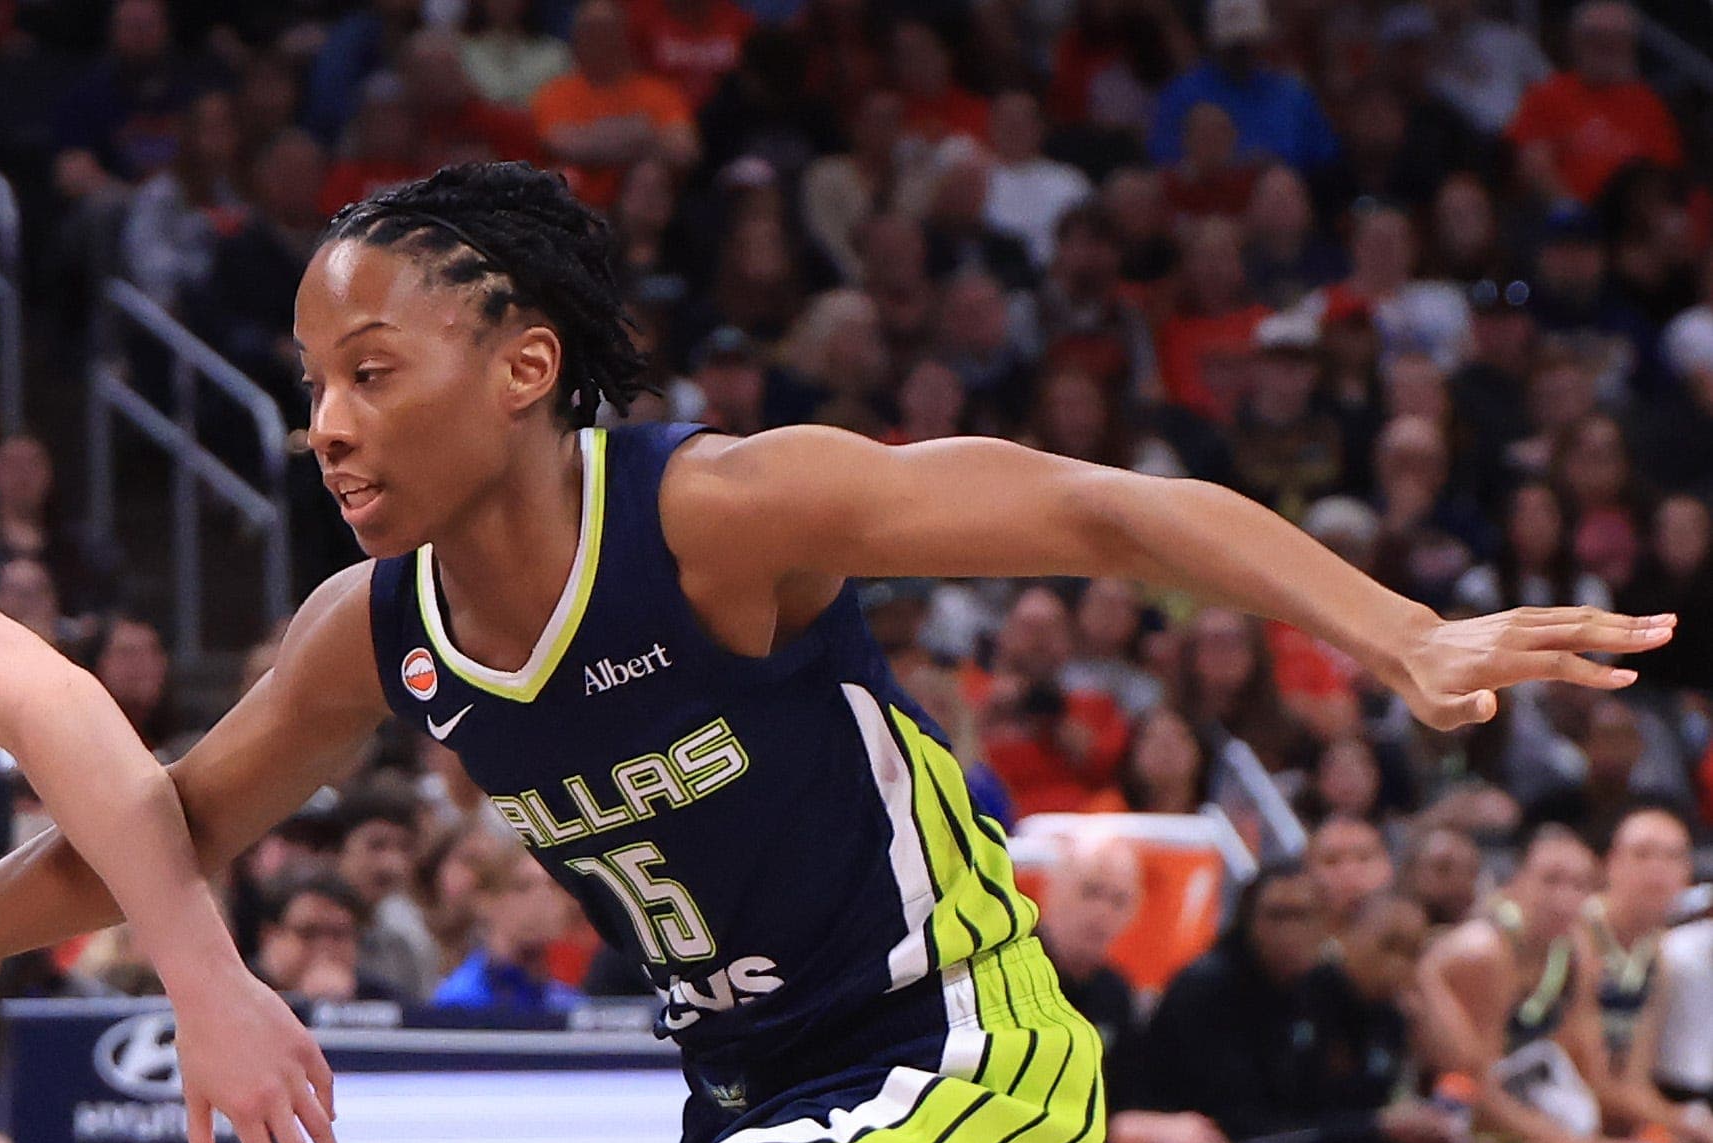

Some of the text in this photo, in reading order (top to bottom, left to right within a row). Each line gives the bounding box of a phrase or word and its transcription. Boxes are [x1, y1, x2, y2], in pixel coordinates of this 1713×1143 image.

[584, 642, 674, 697] Albert
[490, 716, 751, 849] ALLAS
[563, 841, 717, 965] 15
